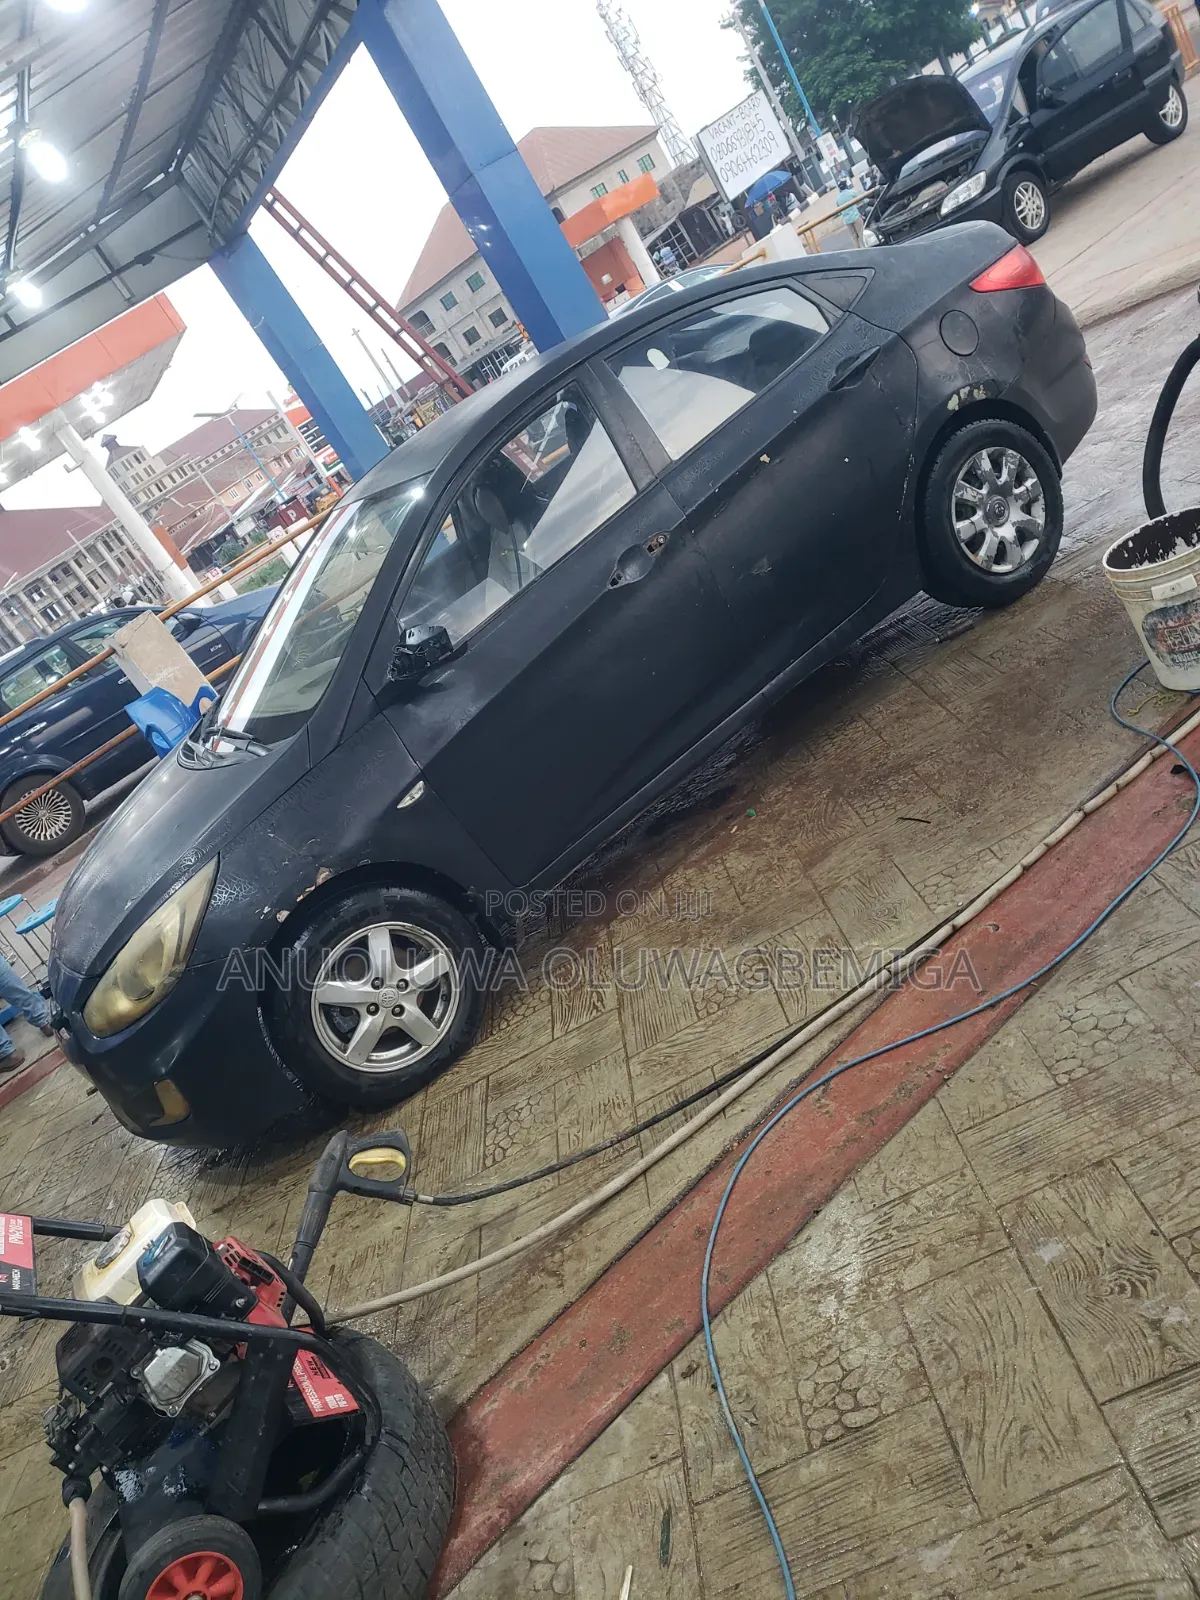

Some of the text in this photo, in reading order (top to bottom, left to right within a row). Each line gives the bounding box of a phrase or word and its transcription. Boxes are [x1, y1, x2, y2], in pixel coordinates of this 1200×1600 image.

[707, 96, 761, 140] VACANT-BOARD
[710, 113, 766, 163] 08066931845
[719, 130, 779, 183] 09064462309
